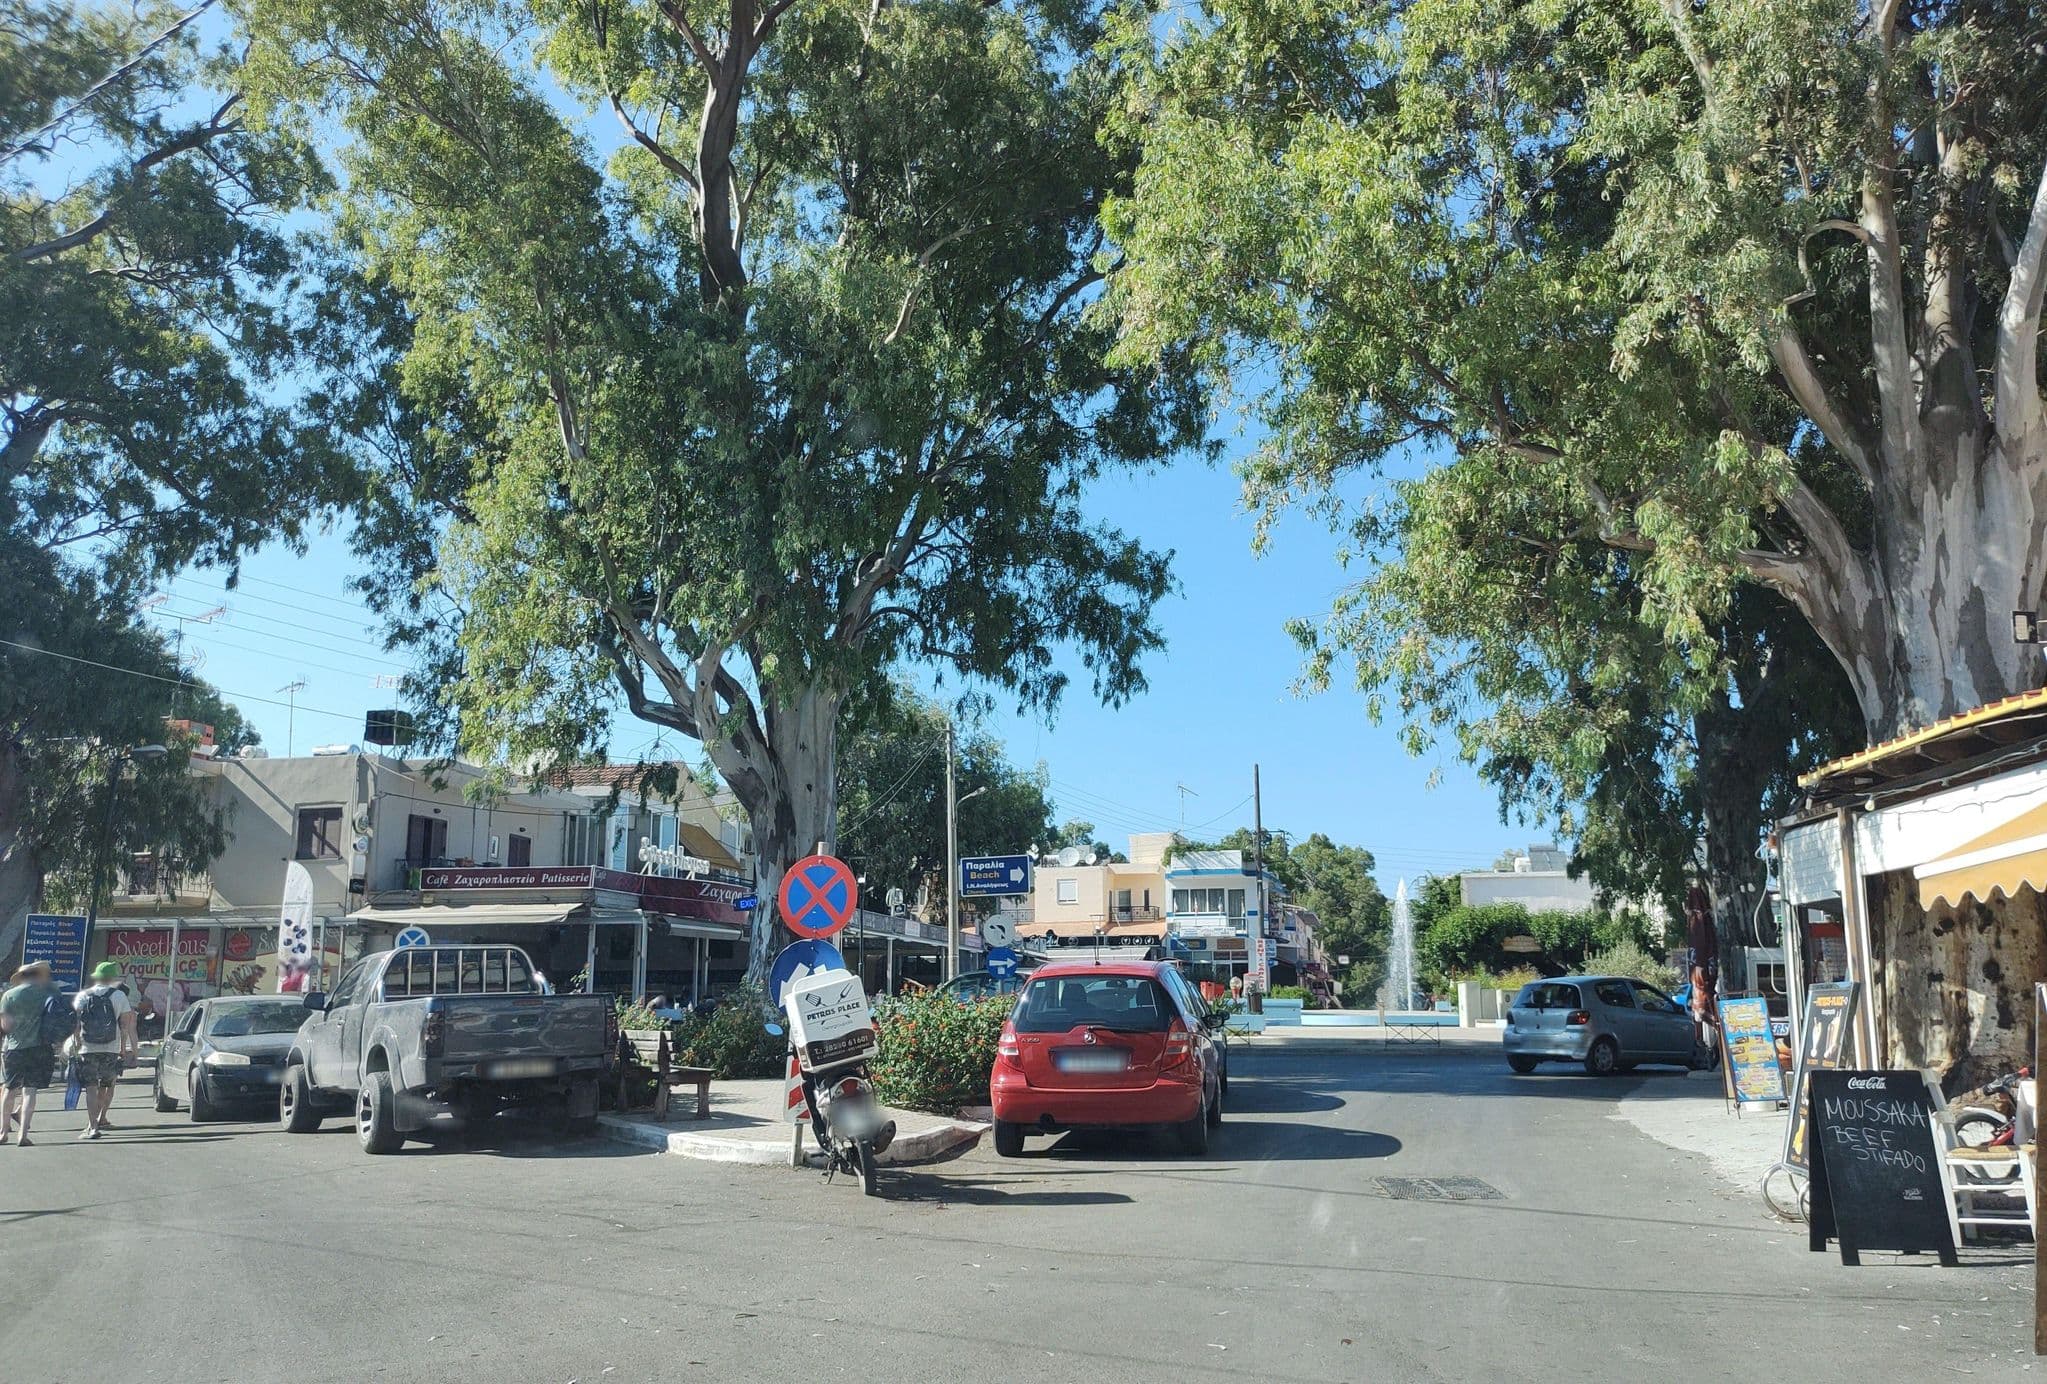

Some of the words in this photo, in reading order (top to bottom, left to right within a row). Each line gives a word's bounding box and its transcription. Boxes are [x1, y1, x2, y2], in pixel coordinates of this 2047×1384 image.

[965, 860, 1005, 871] Παραλία
[969, 871, 1000, 880] Beach
[454, 873, 535, 888] Ζαχαροπλαστείο
[541, 872, 589, 884] Patisserie
[806, 1008, 836, 1021] PETROS
[837, 1001, 861, 1013] PLACE
[1825, 1096, 1926, 1128] MOUSSAKA
[1826, 1125, 1895, 1148] BEEF
[1851, 1144, 1926, 1173] STIFADO
